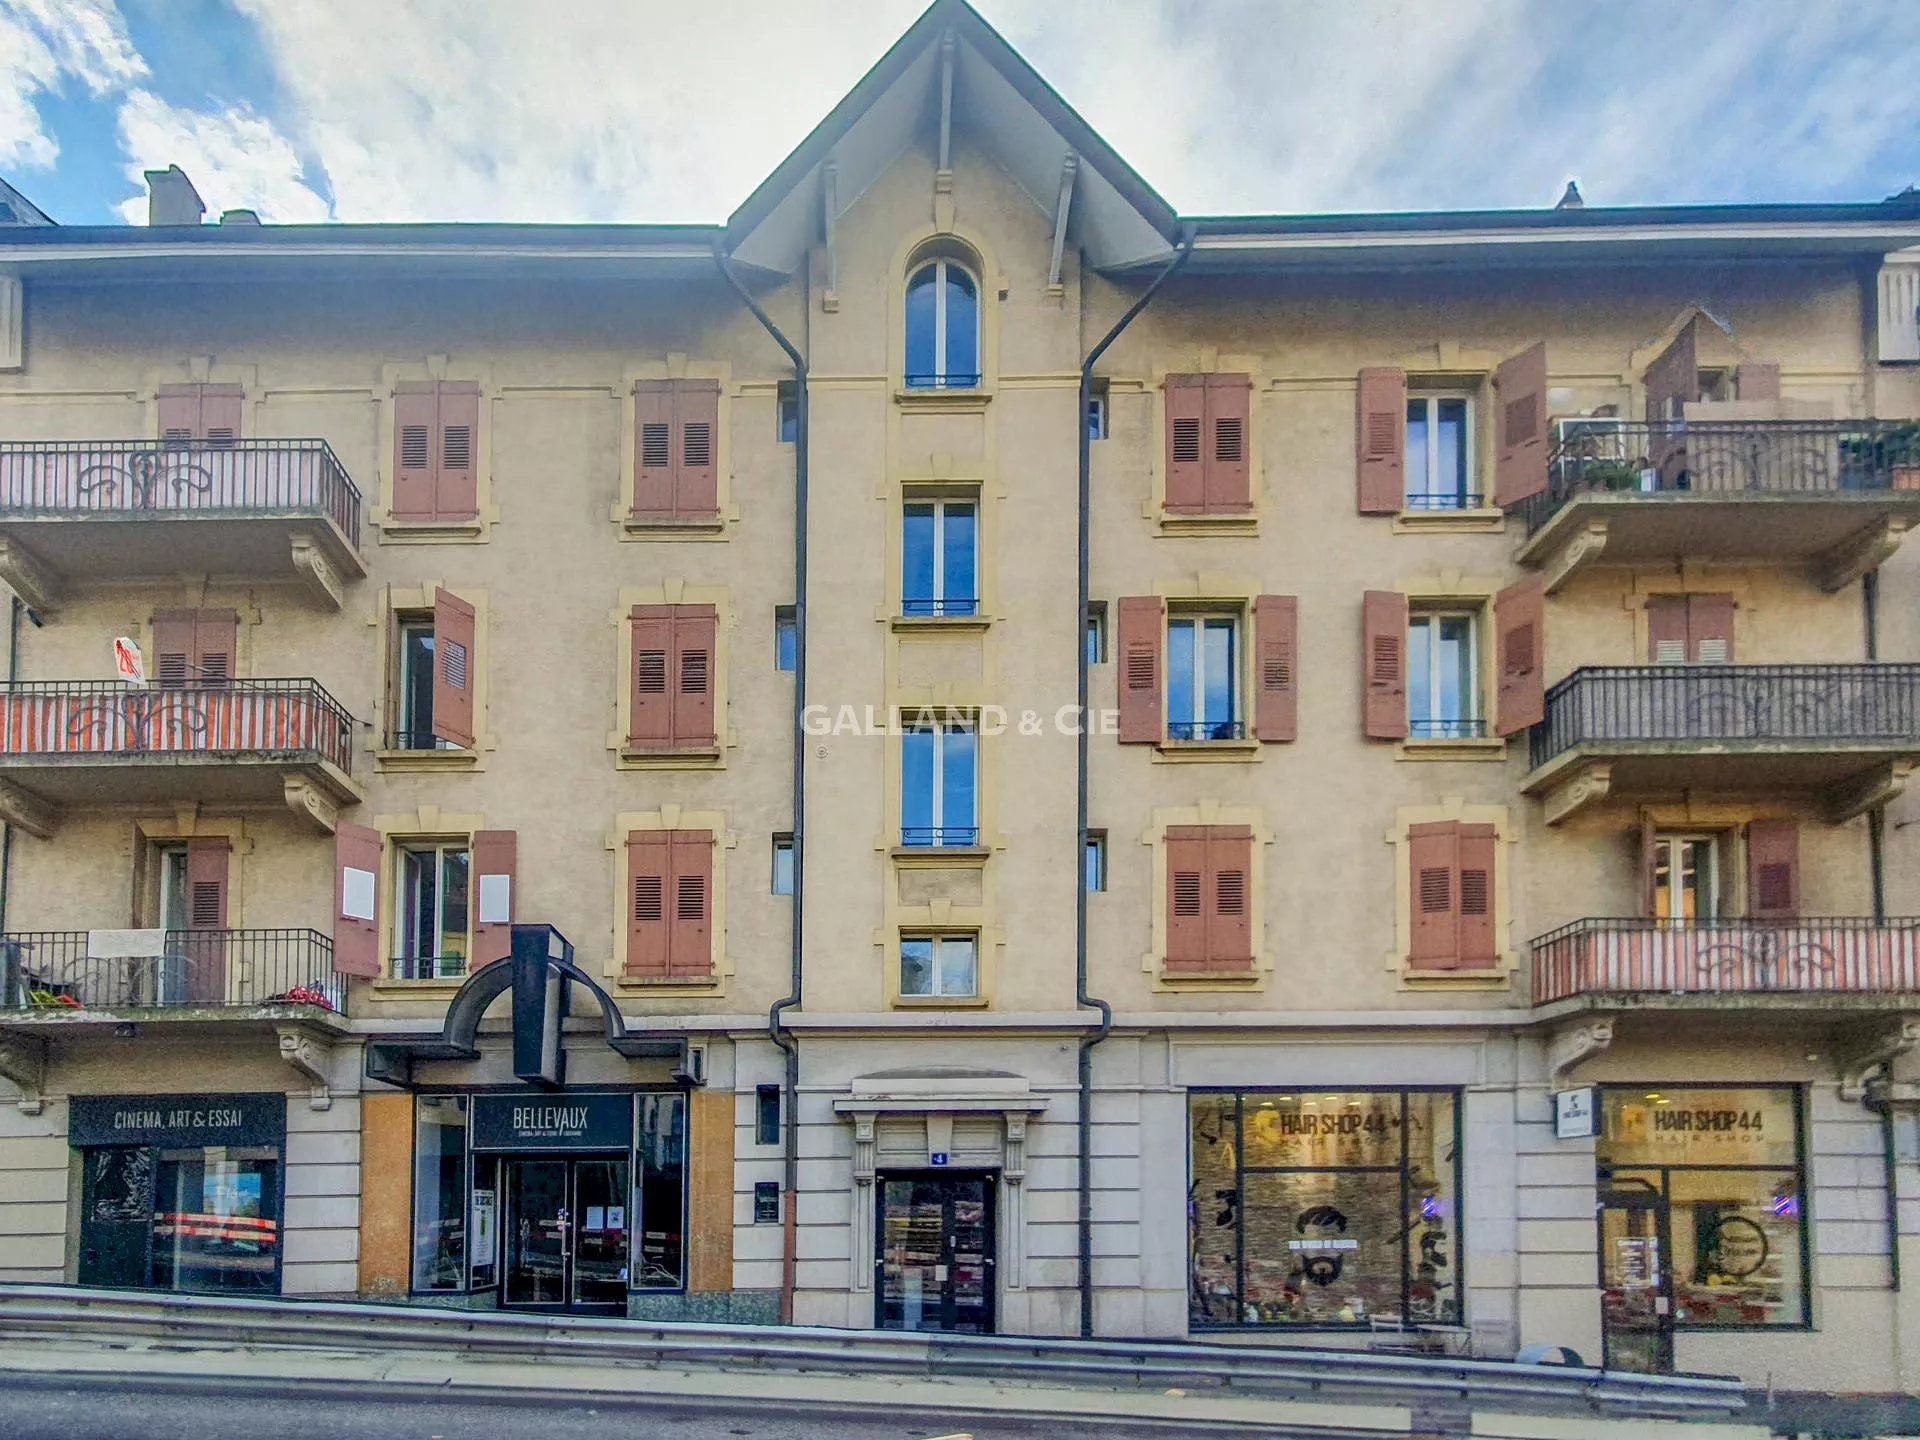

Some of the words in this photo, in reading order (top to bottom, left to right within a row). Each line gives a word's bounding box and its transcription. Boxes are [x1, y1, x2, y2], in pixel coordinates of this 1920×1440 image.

[114, 1111, 165, 1129] CINEMA,
[168, 1110, 192, 1127] ART
[193, 1111, 205, 1127] &
[208, 1109, 242, 1127] ESSAI
[513, 1107, 588, 1136] BELLEVAUX
[1281, 1114, 1317, 1134] HAIR
[1322, 1114, 1361, 1134] SHOP
[1655, 1110, 1692, 1131] HAIR
[1695, 1110, 1737, 1131] SHOP
[1738, 1110, 1762, 1130] 44
